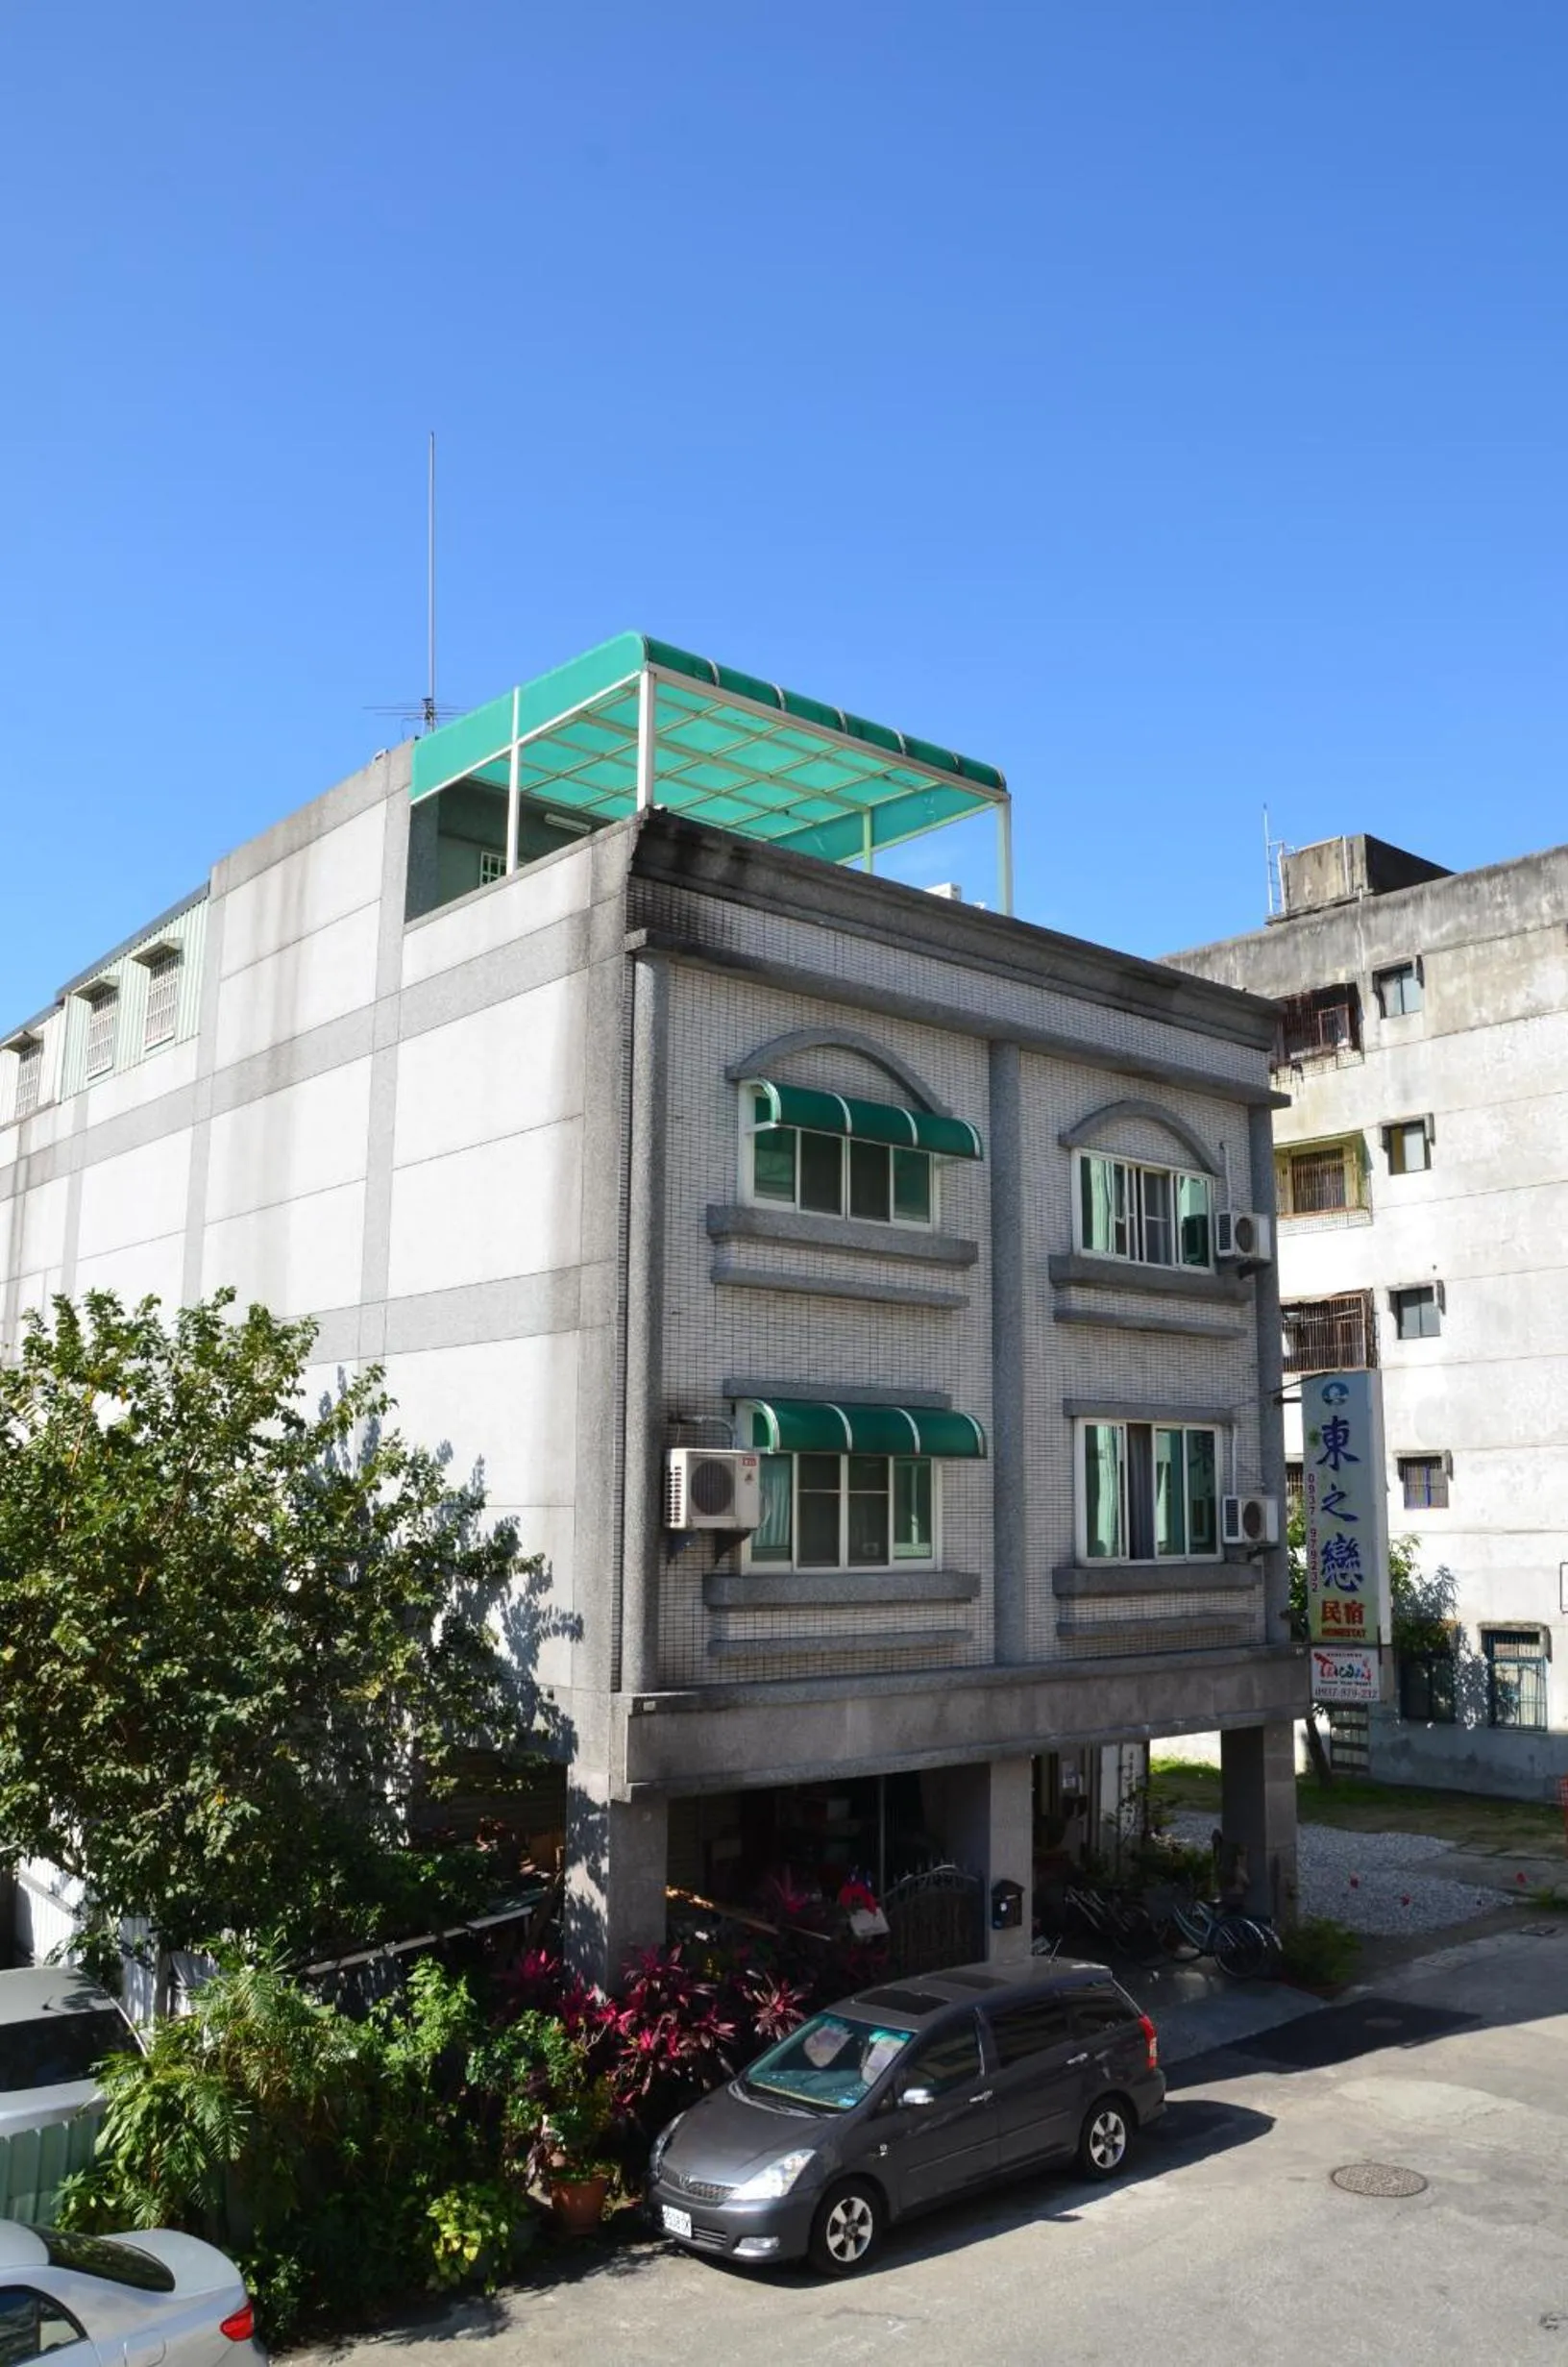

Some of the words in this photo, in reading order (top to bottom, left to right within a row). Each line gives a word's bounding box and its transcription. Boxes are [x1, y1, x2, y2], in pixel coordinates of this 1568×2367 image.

[1315, 1415, 1363, 1592] 東之戀
[1321, 1599, 1365, 1624] 民宿
